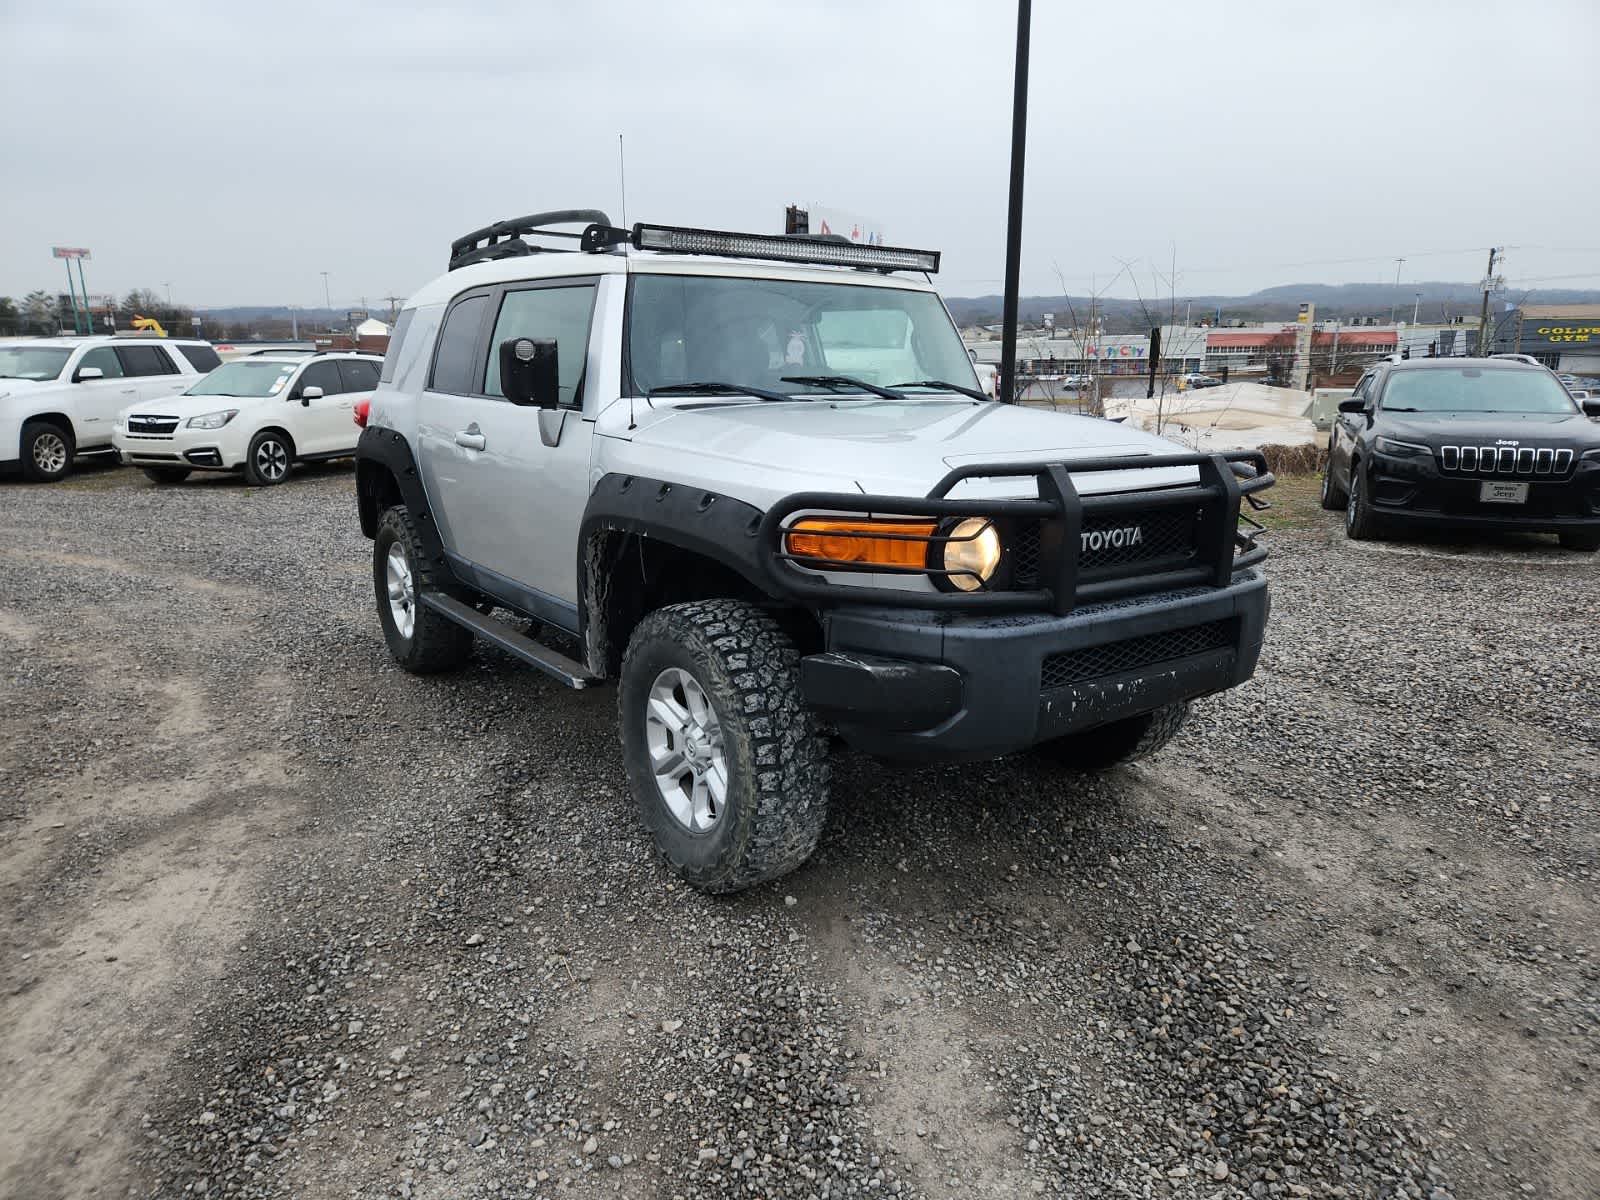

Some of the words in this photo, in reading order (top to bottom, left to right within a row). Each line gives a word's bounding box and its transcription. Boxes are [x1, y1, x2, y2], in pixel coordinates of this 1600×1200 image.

[1120, 344, 1145, 358] City
[1495, 439, 1520, 447] Jeep
[1080, 526, 1144, 552] TOYOTA
